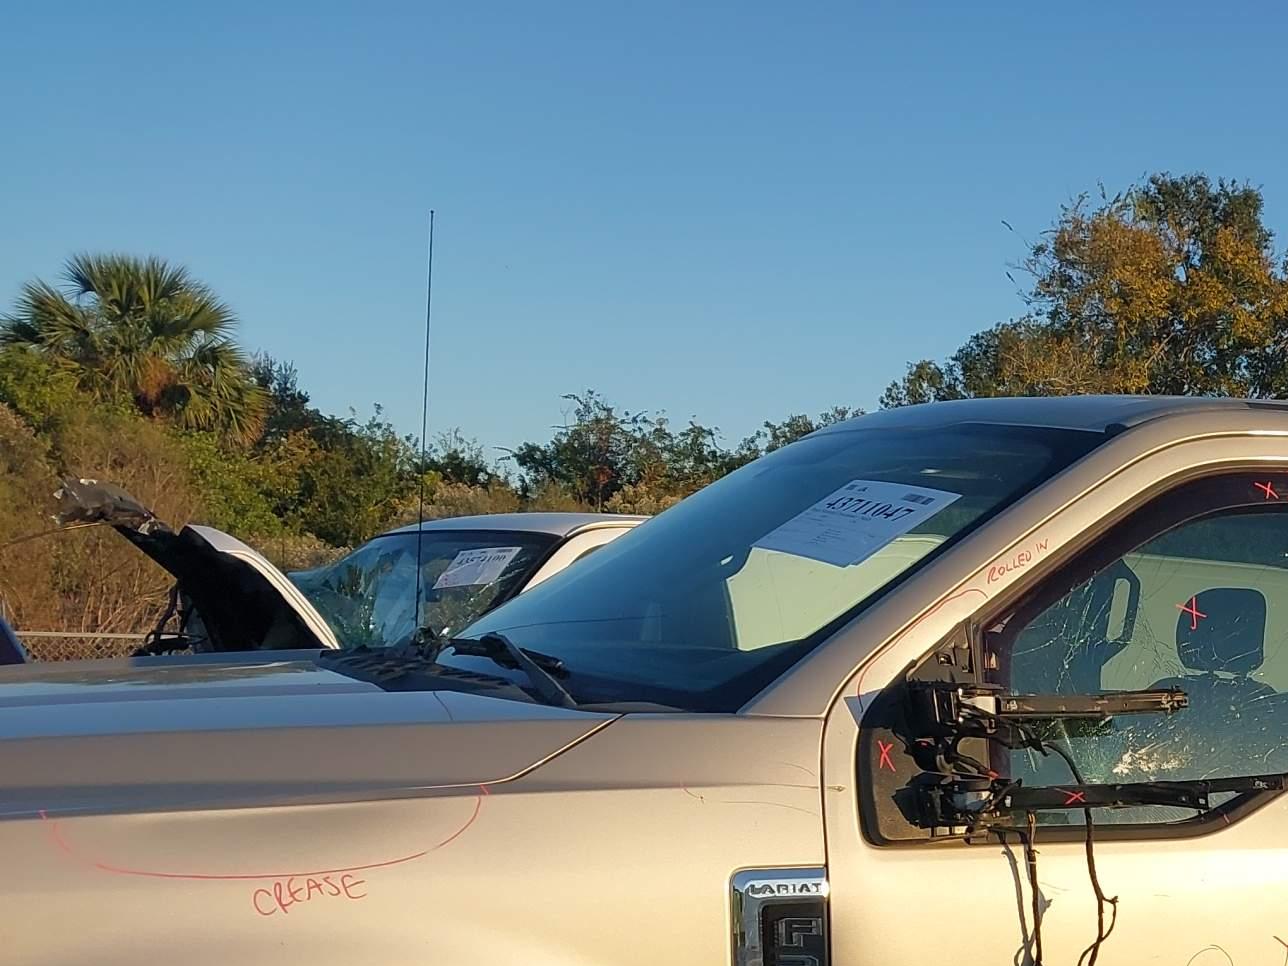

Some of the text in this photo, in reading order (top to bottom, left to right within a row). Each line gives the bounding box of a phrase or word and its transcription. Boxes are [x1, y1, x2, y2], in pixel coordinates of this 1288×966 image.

[826, 496, 915, 522] 43711047
[987, 538, 1049, 584] ROLLED IN
[253, 874, 368, 916] CREASE
[750, 883, 822, 896] LARIAT
